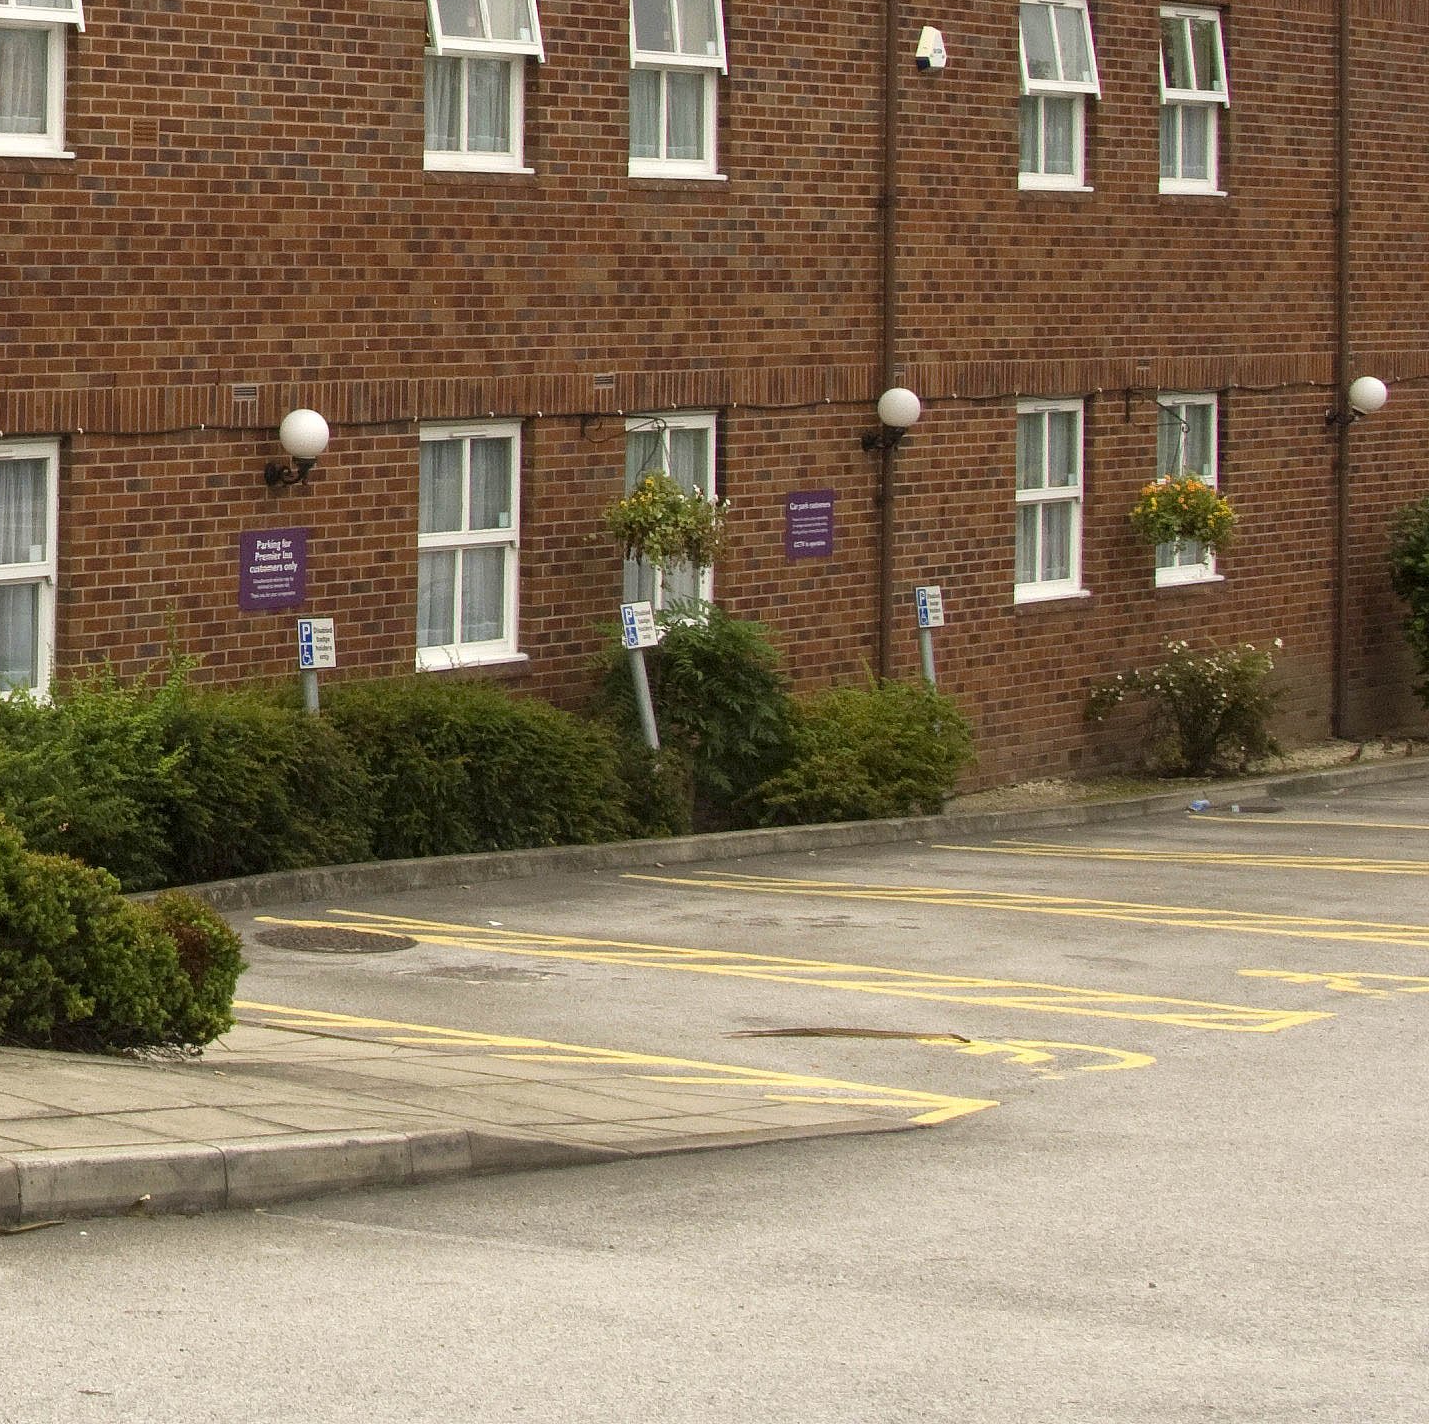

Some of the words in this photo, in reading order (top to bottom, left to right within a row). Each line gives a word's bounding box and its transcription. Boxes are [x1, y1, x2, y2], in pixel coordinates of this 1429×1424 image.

[256, 539, 281, 551] Parking
[282, 538, 292, 548] for
[254, 551, 281, 561] Premier
